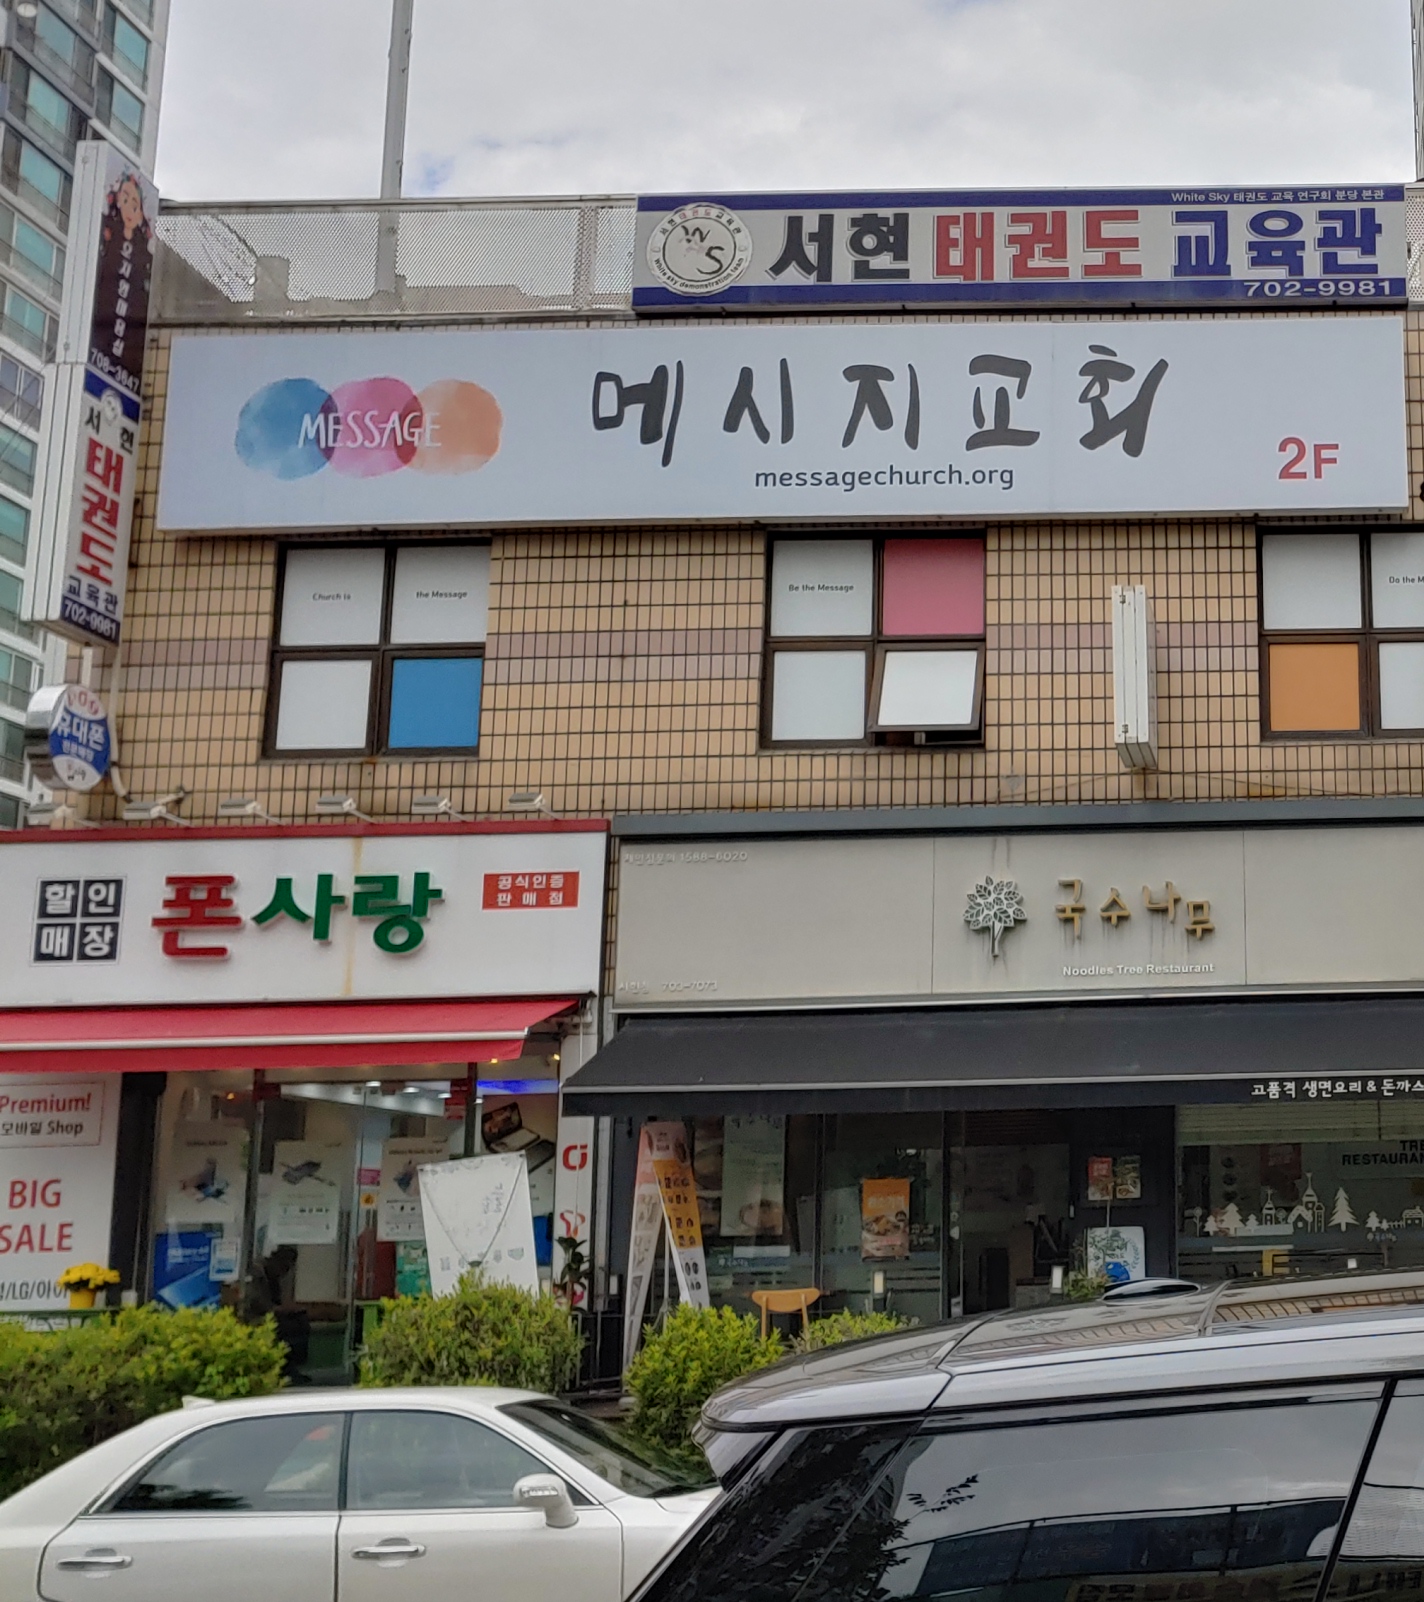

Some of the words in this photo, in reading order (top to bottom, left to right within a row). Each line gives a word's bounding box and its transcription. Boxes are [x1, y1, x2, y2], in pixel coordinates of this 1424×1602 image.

[1171, 191, 1206, 203] White
[1208, 191, 1231, 204] Sky
[1233, 191, 1268, 203] 태권도
[1271, 191, 1295, 202] 교육
[1297, 189, 1332, 202] 연구회
[1335, 189, 1359, 202] 분당
[1361, 189, 1385, 201] 본관
[765, 212, 911, 284] 서현
[932, 209, 1143, 283] 태권도
[1172, 206, 1383, 278] 교육관
[1243, 280, 1393, 298] 702-9981
[297, 410, 442, 449] MESSAGE
[1277, 436, 1340, 480] 2F
[755, 463, 1015, 492] messagechurch.org
[76, 436, 124, 587] 태권도
[416, 589, 430, 599] the
[431, 590, 468, 600] Message
[788, 583, 800, 592] Be
[801, 583, 816, 592] the
[817, 583, 855, 593] Message
[1388, 575, 1400, 584] Do
[1402, 575, 1416, 584] the
[67, 575, 119, 616] 교육관
[497, 873, 565, 890] 공식인증
[42, 880, 117, 916] 할인
[1055, 878, 1216, 940] 국수나무
[151, 871, 445, 960] 폰사랑
[39, 923, 116, 957] 매장
[1062, 965, 1114, 977] Noodles
[1116, 964, 1144, 976] Tree
[1146, 962, 1216, 975] Restaurant
[1250, 1080, 1297, 1099] 고품격
[1302, 1079, 1363, 1098] 생면요리
[1366, 1081, 1378, 1093] &
[46, 1120, 84, 1136] Shop
[8, 1178, 62, 1209] BIG
[0, 1222, 73, 1254] SALE
